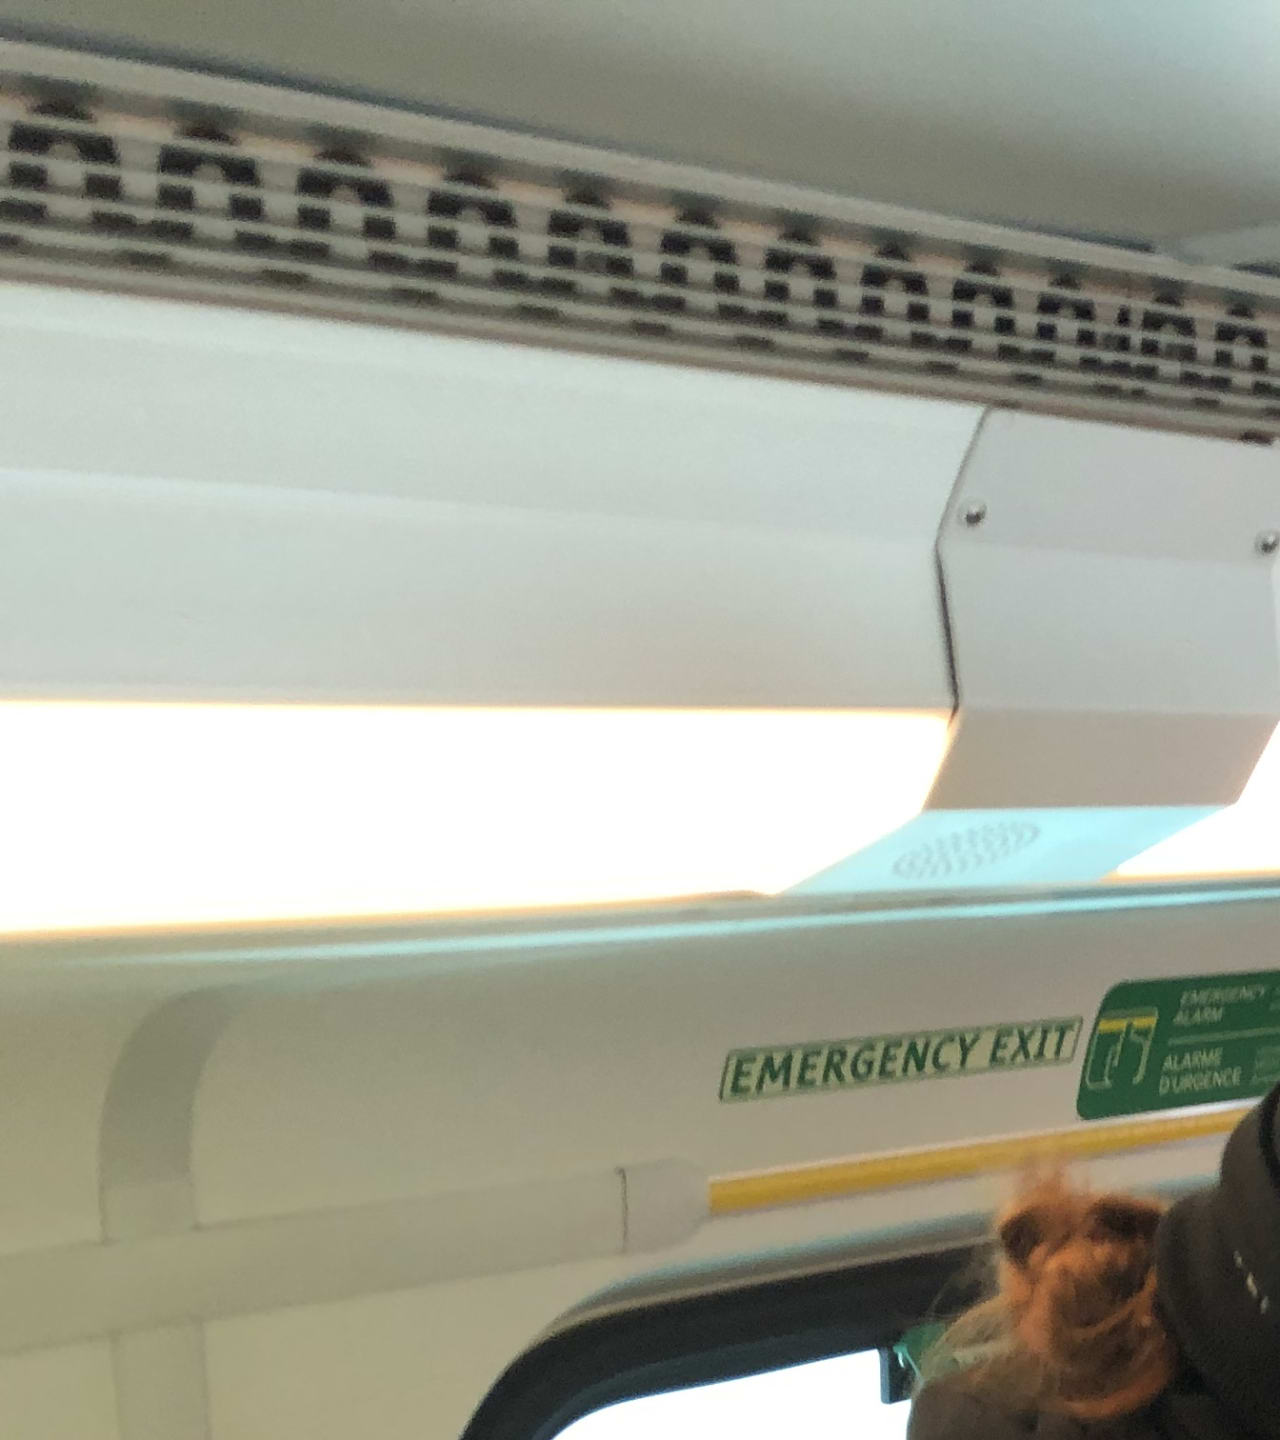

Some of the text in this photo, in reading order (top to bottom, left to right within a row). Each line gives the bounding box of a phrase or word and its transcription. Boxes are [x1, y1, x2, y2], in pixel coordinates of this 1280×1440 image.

[729, 1022, 1075, 1096] EMERGENCY EXIT
[1163, 1047, 1223, 1071] ALARME
